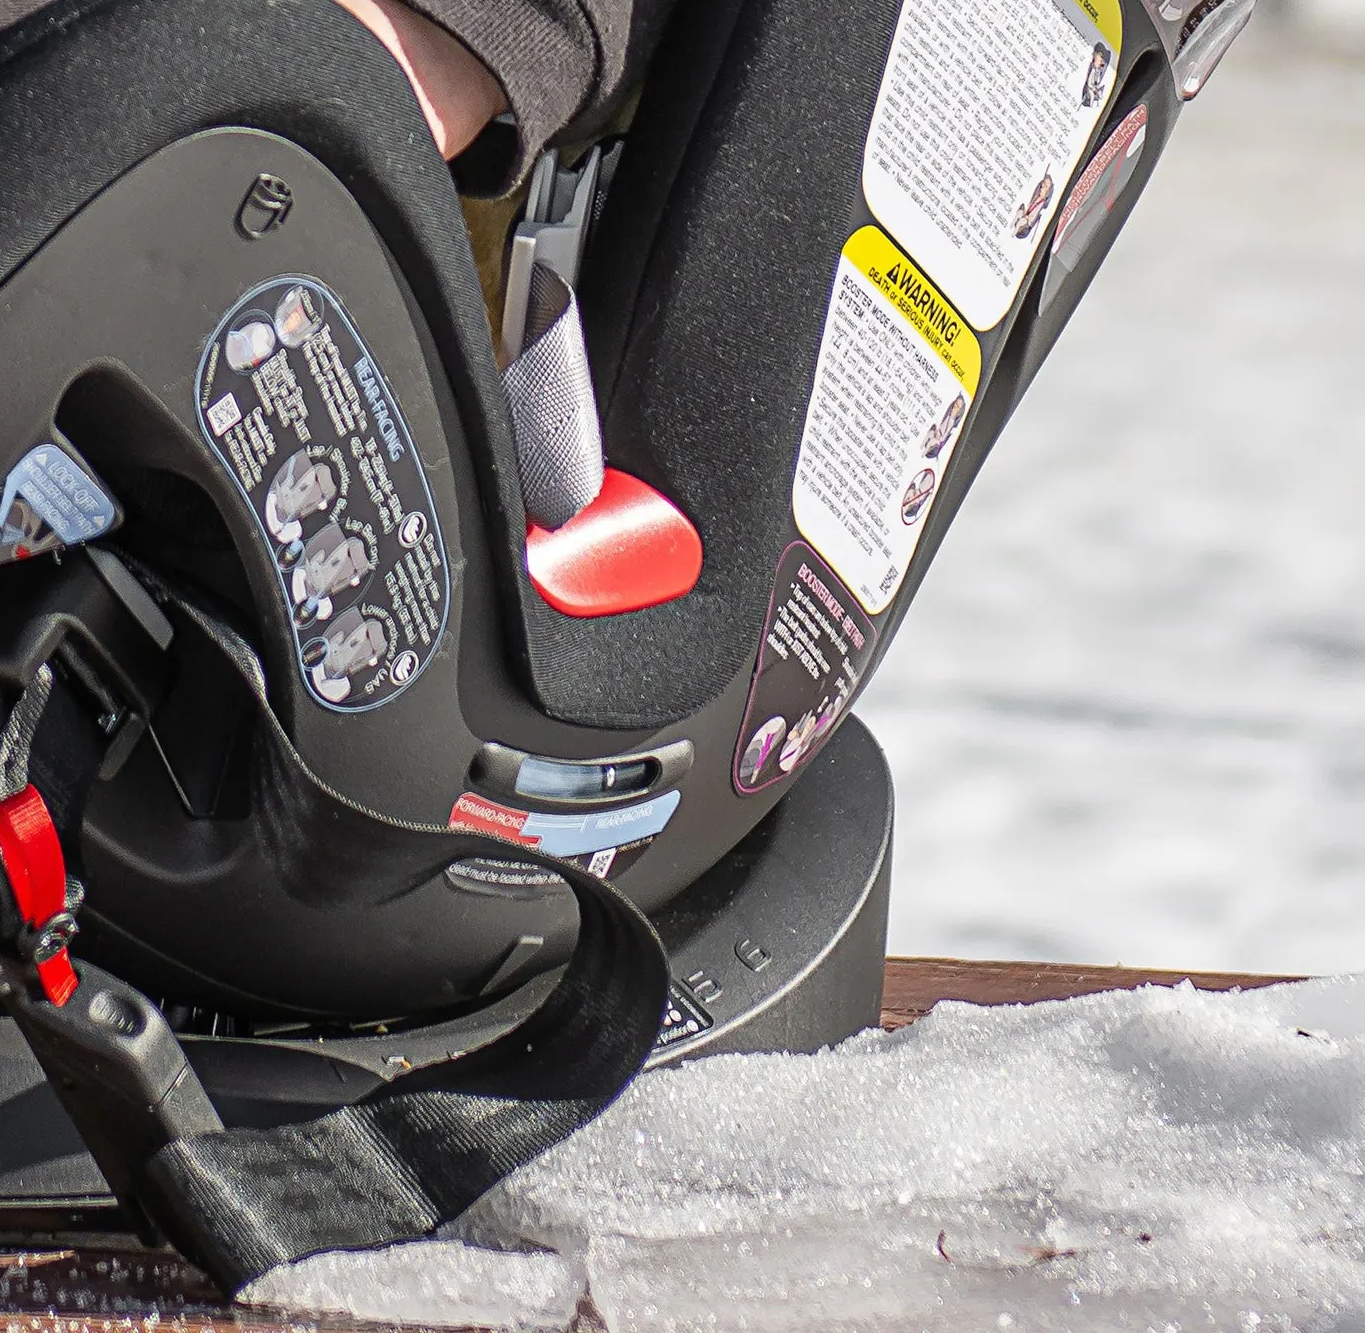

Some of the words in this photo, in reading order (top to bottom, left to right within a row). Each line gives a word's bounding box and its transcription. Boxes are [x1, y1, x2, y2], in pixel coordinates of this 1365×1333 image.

[839, 272, 874, 310] BOOSTER
[869, 303, 891, 329] MODE
[886, 322, 915, 355] WITHOUT
[910, 349, 940, 383] HARNESS
[866, 265, 892, 295] DEATH
[887, 290, 897, 302] or
[894, 295, 926, 331] SERIOUS
[920, 324, 944, 352] INJURY
[939, 347, 953, 364] can
[894, 268, 964, 348] WARNING!
[351, 355, 406, 464] REAR-FACING
[46, 459, 100, 517] LOCK-OFF
[796, 560, 829, 605] BOOSTER
[823, 592, 845, 623] MODE
[455, 796, 525, 830] FORWARD-FACING
